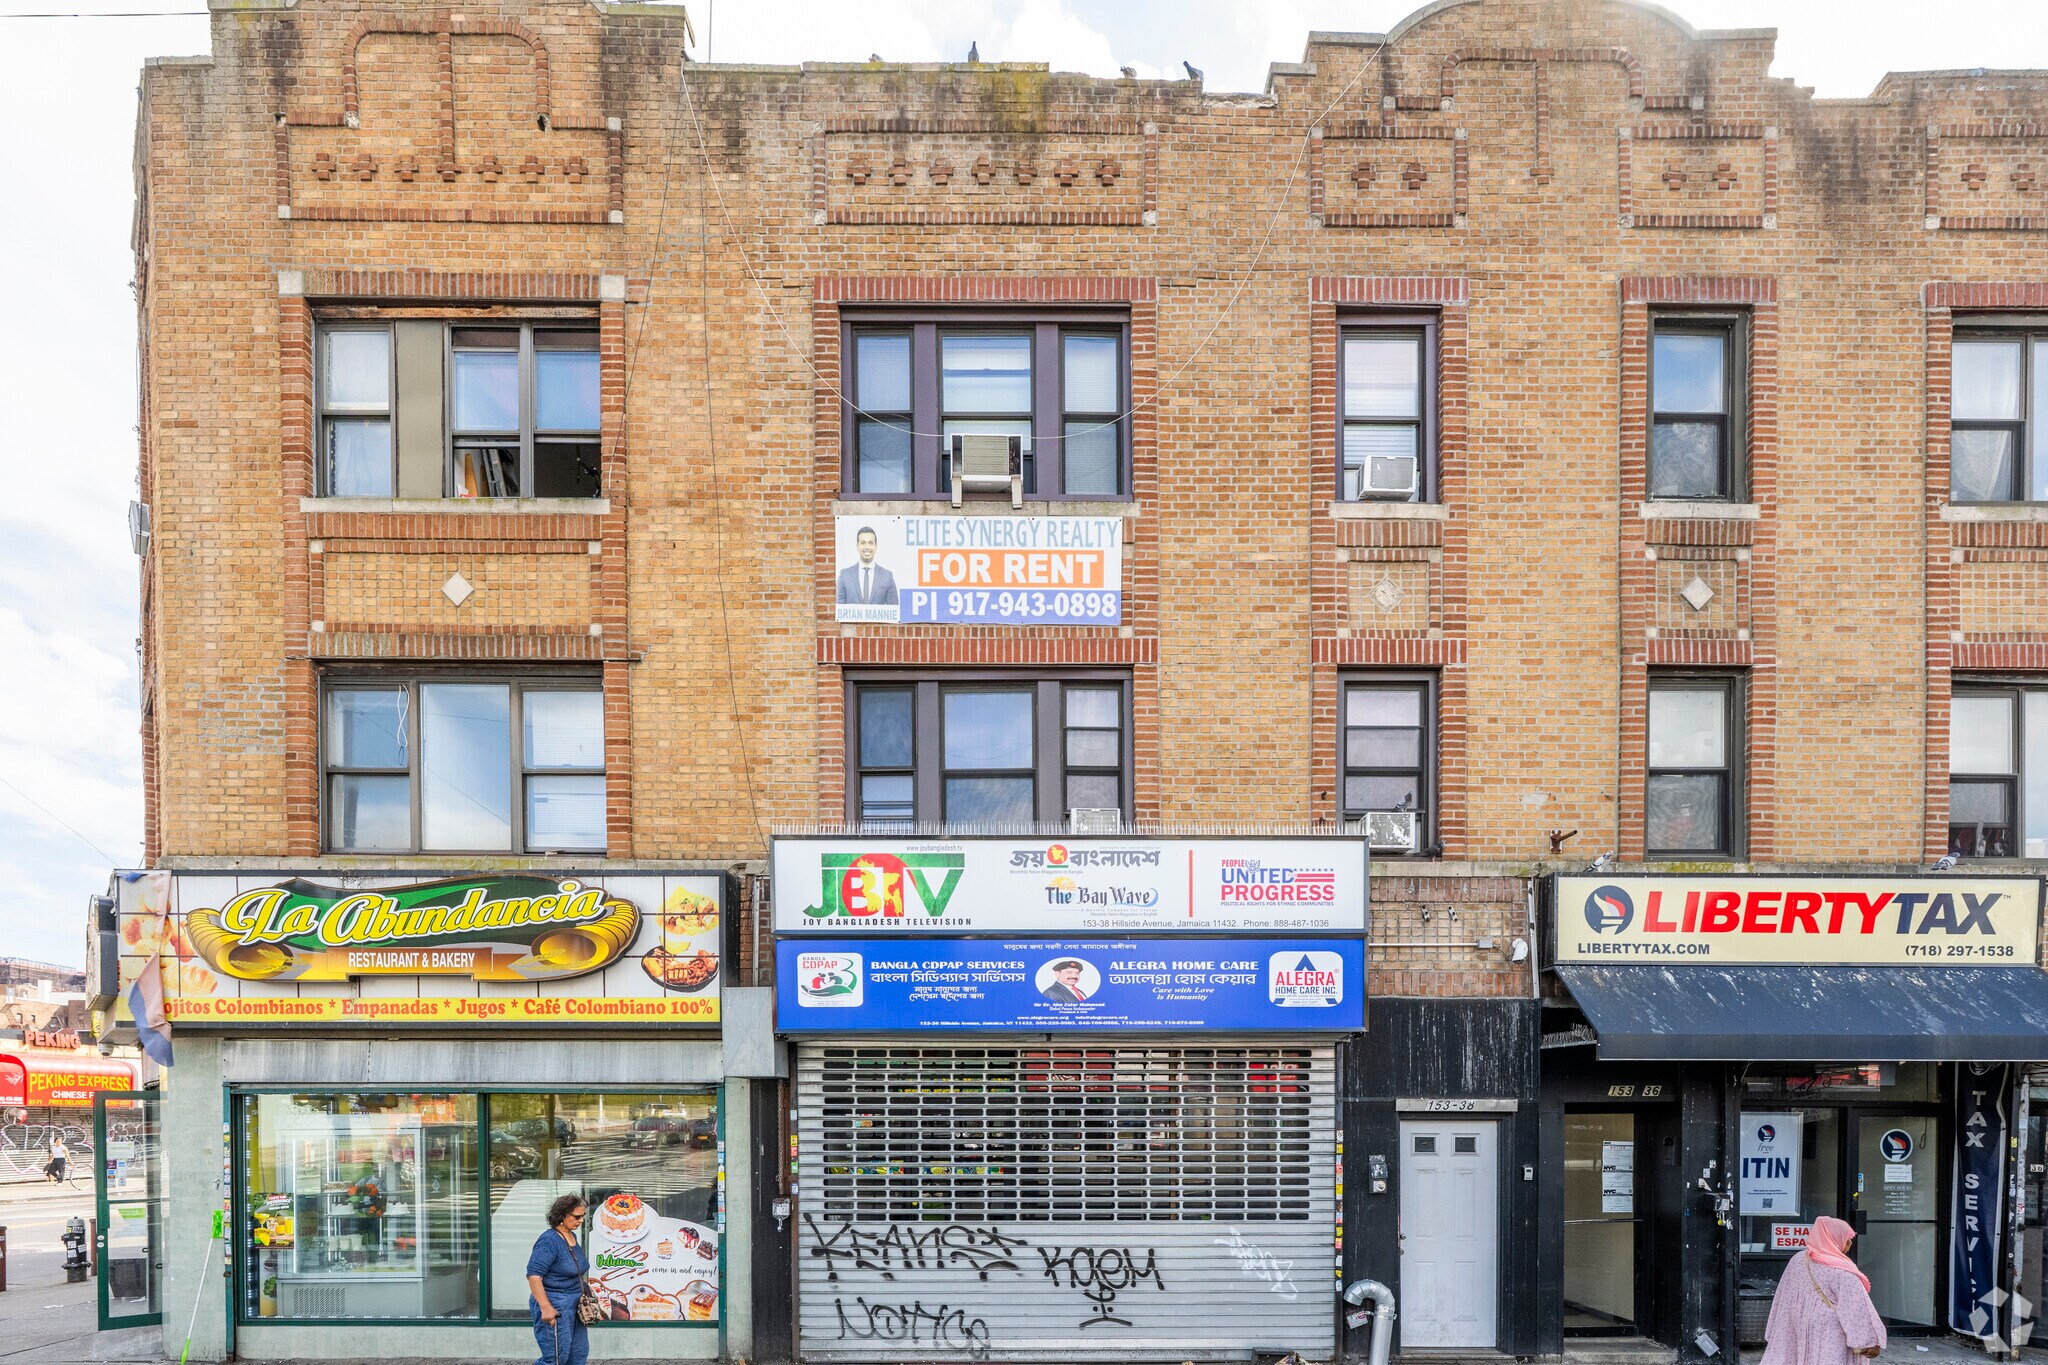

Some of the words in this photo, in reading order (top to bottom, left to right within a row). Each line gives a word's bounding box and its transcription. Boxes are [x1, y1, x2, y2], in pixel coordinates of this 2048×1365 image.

[905, 520, 951, 547] ELITE
[956, 520, 1040, 547] SYNERGY
[1049, 520, 1118, 548] REALTY
[922, 553, 992, 583] FOR
[1004, 554, 1098, 584] RENT
[949, 591, 1117, 617] 917-943-0898
[837, 608, 863, 620] BRIAN
[865, 609, 898, 621] MANNIE
[906, 844, 963, 852] www.joybangladesh.tv
[1009, 850, 1046, 868] জয়
[1069, 850, 1161, 868] বাংলাদেশ
[1221, 859, 1244, 867] PEOPLE
[1222, 868, 1295, 883] UNITED
[1045, 887, 1072, 905] The
[1077, 887, 1108, 909] Bay
[1109, 887, 1150, 905] Wave
[1221, 885, 1335, 901] PROGRESS
[221, 888, 319, 945] La
[318, 880, 605, 947] Abundancia
[803, 918, 822, 926] JOY
[828, 918, 900, 926] BANGLADESH
[906, 918, 972, 926] TELEVISION
[1112, 919, 1142, 927] Hillside
[1143, 920, 1174, 929] Avenue,
[1578, 943, 1710, 954] LIBERTYTAX.COM
[1905, 945, 1942, 956] (718)
[1947, 945, 2014, 956] 297-1538
[349, 952, 419, 968] RESTAURANT
[422, 953, 429, 968] &
[432, 952, 475, 968] BAKERY
[803, 961, 838, 969] CDPAP
[870, 961, 917, 970] BANGLA
[922, 961, 963, 970] CDPAP
[967, 961, 1026, 970] SERVICES
[1109, 961, 1167, 970] ALEGRA
[1172, 961, 1216, 970] HOME
[1220, 961, 1259, 970] CARE
[870, 972, 908, 984] বাংলা
[1175, 973, 1205, 985] হোম
[1275, 971, 1336, 986] ALEGRA
[1275, 986, 1297, 994] HOME
[1300, 986, 1320, 994] CARE
[1322, 986, 1338, 994] INC.
[1166, 994, 1208, 1002] Humanity
[164, 999, 210, 1017] ojitos
[215, 999, 323, 1015] Colombianos
[342, 999, 438, 1018] Empanadas
[456, 999, 506, 1018] Jugos
[523, 998, 560, 1015] Café
[565, 998, 666, 1015] Colombiano
[670, 999, 713, 1015] 100%
[25, 1030, 81, 1048] PEKING
[29, 1072, 75, 1093] PEKING
[78, 1074, 130, 1091] EXPRESS
[52, 1090, 87, 1099] CHINESE
[1610, 1086, 1633, 1096] 153
[1428, 1100, 1475, 1111] 153-38
[1965, 1090, 1987, 1148] TAX
[1757, 1143, 1775, 1151] free
[1742, 1157, 1790, 1179] ITIN
[1775, 1227, 1789, 1236] SE
[1777, 1238, 1806, 1247] ESPA
[680, 1265, 692, 1274] and
[694, 1265, 717, 1277] enjoy!
